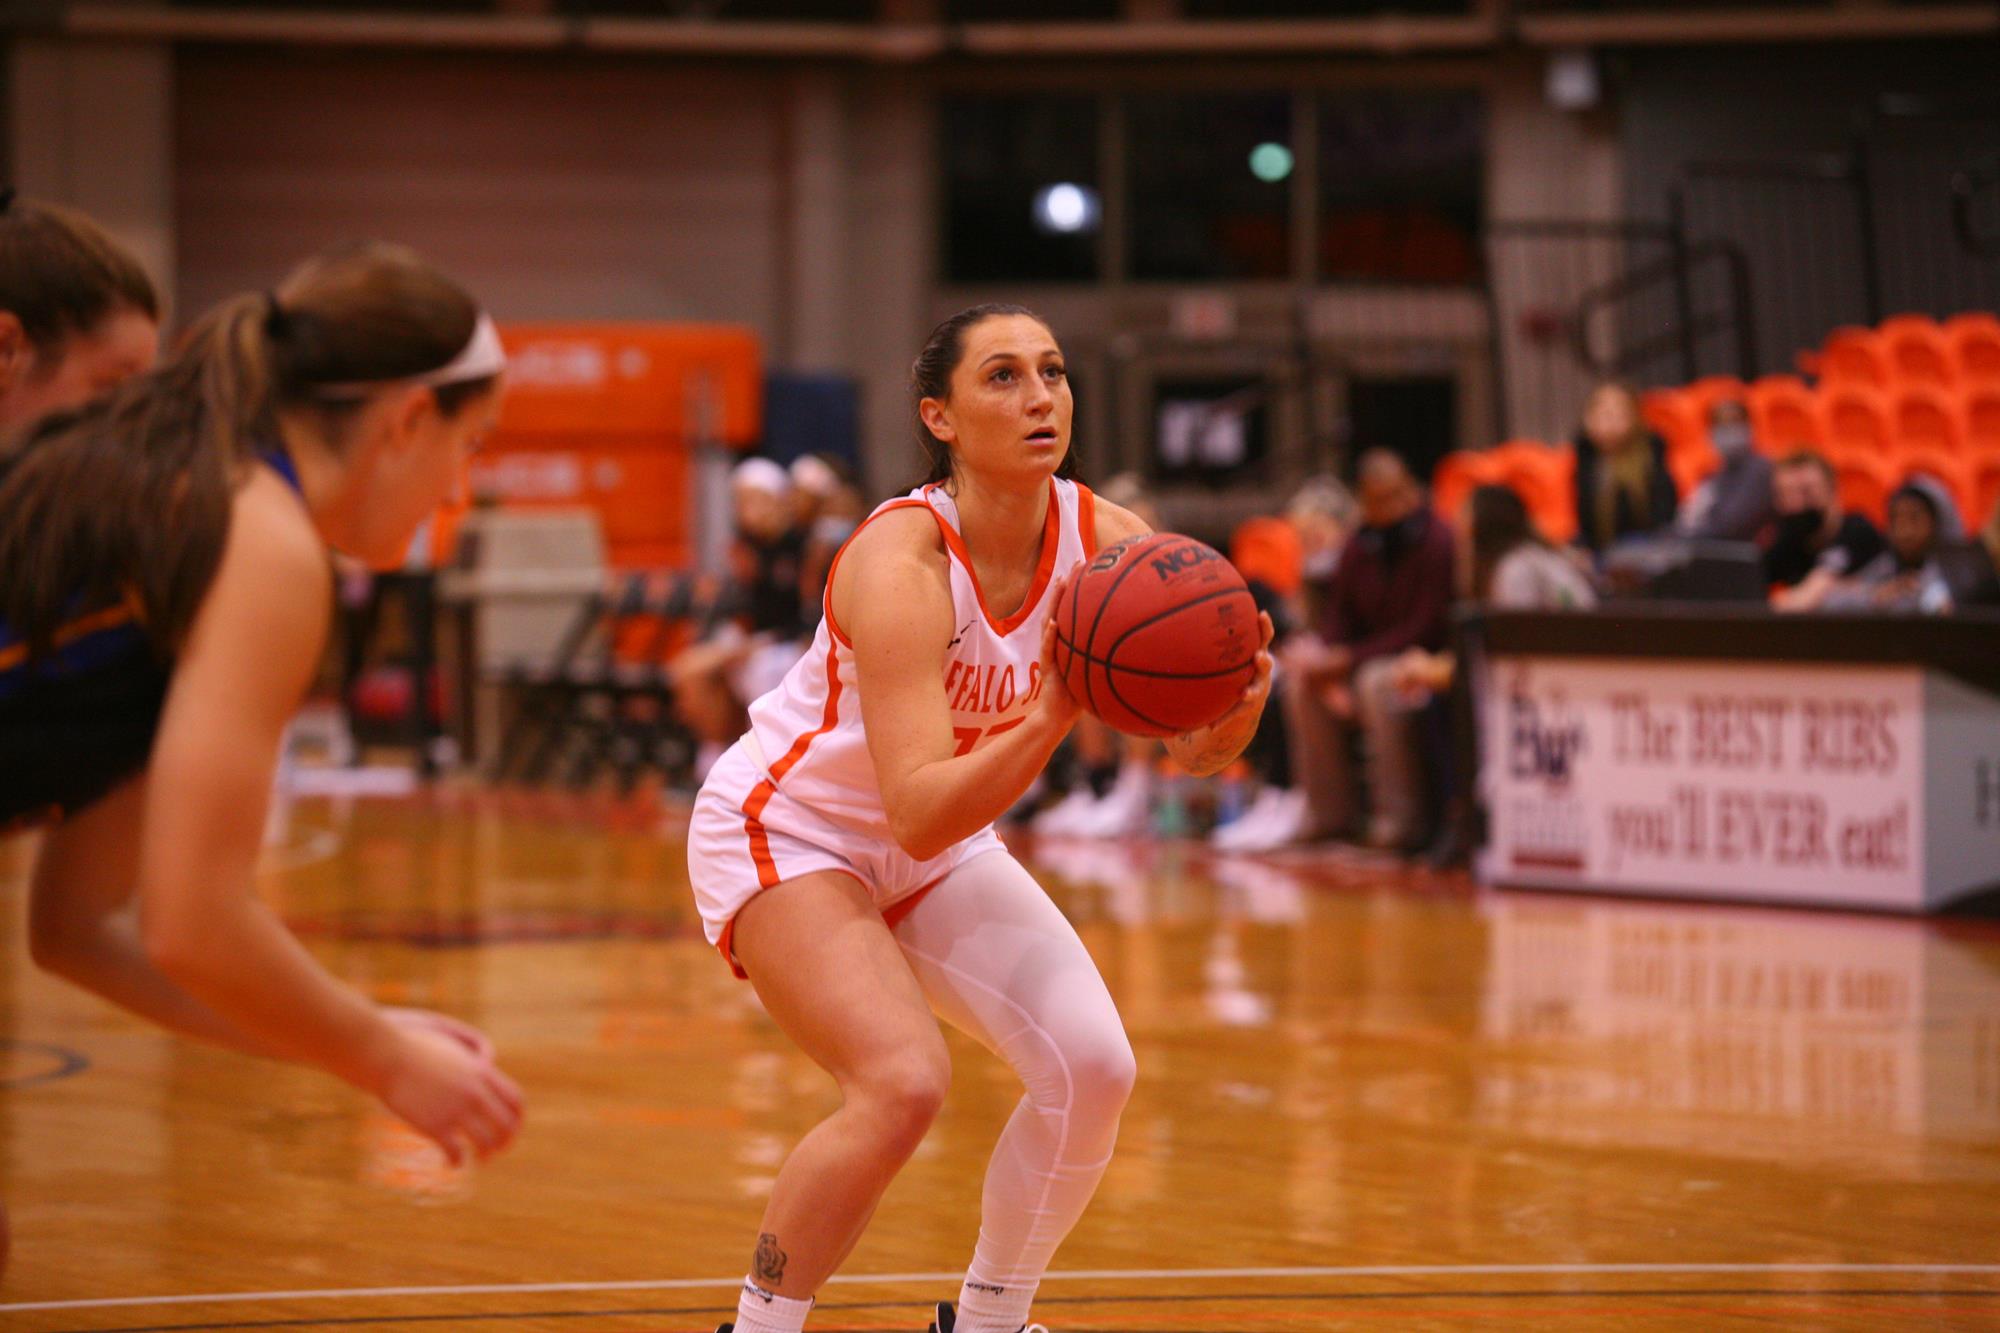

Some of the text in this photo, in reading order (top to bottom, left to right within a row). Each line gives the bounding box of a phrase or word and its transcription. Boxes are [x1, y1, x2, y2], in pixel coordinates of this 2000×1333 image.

[1607, 692, 1898, 777] The BEST RIBS
[1714, 788, 1832, 867] EVER
